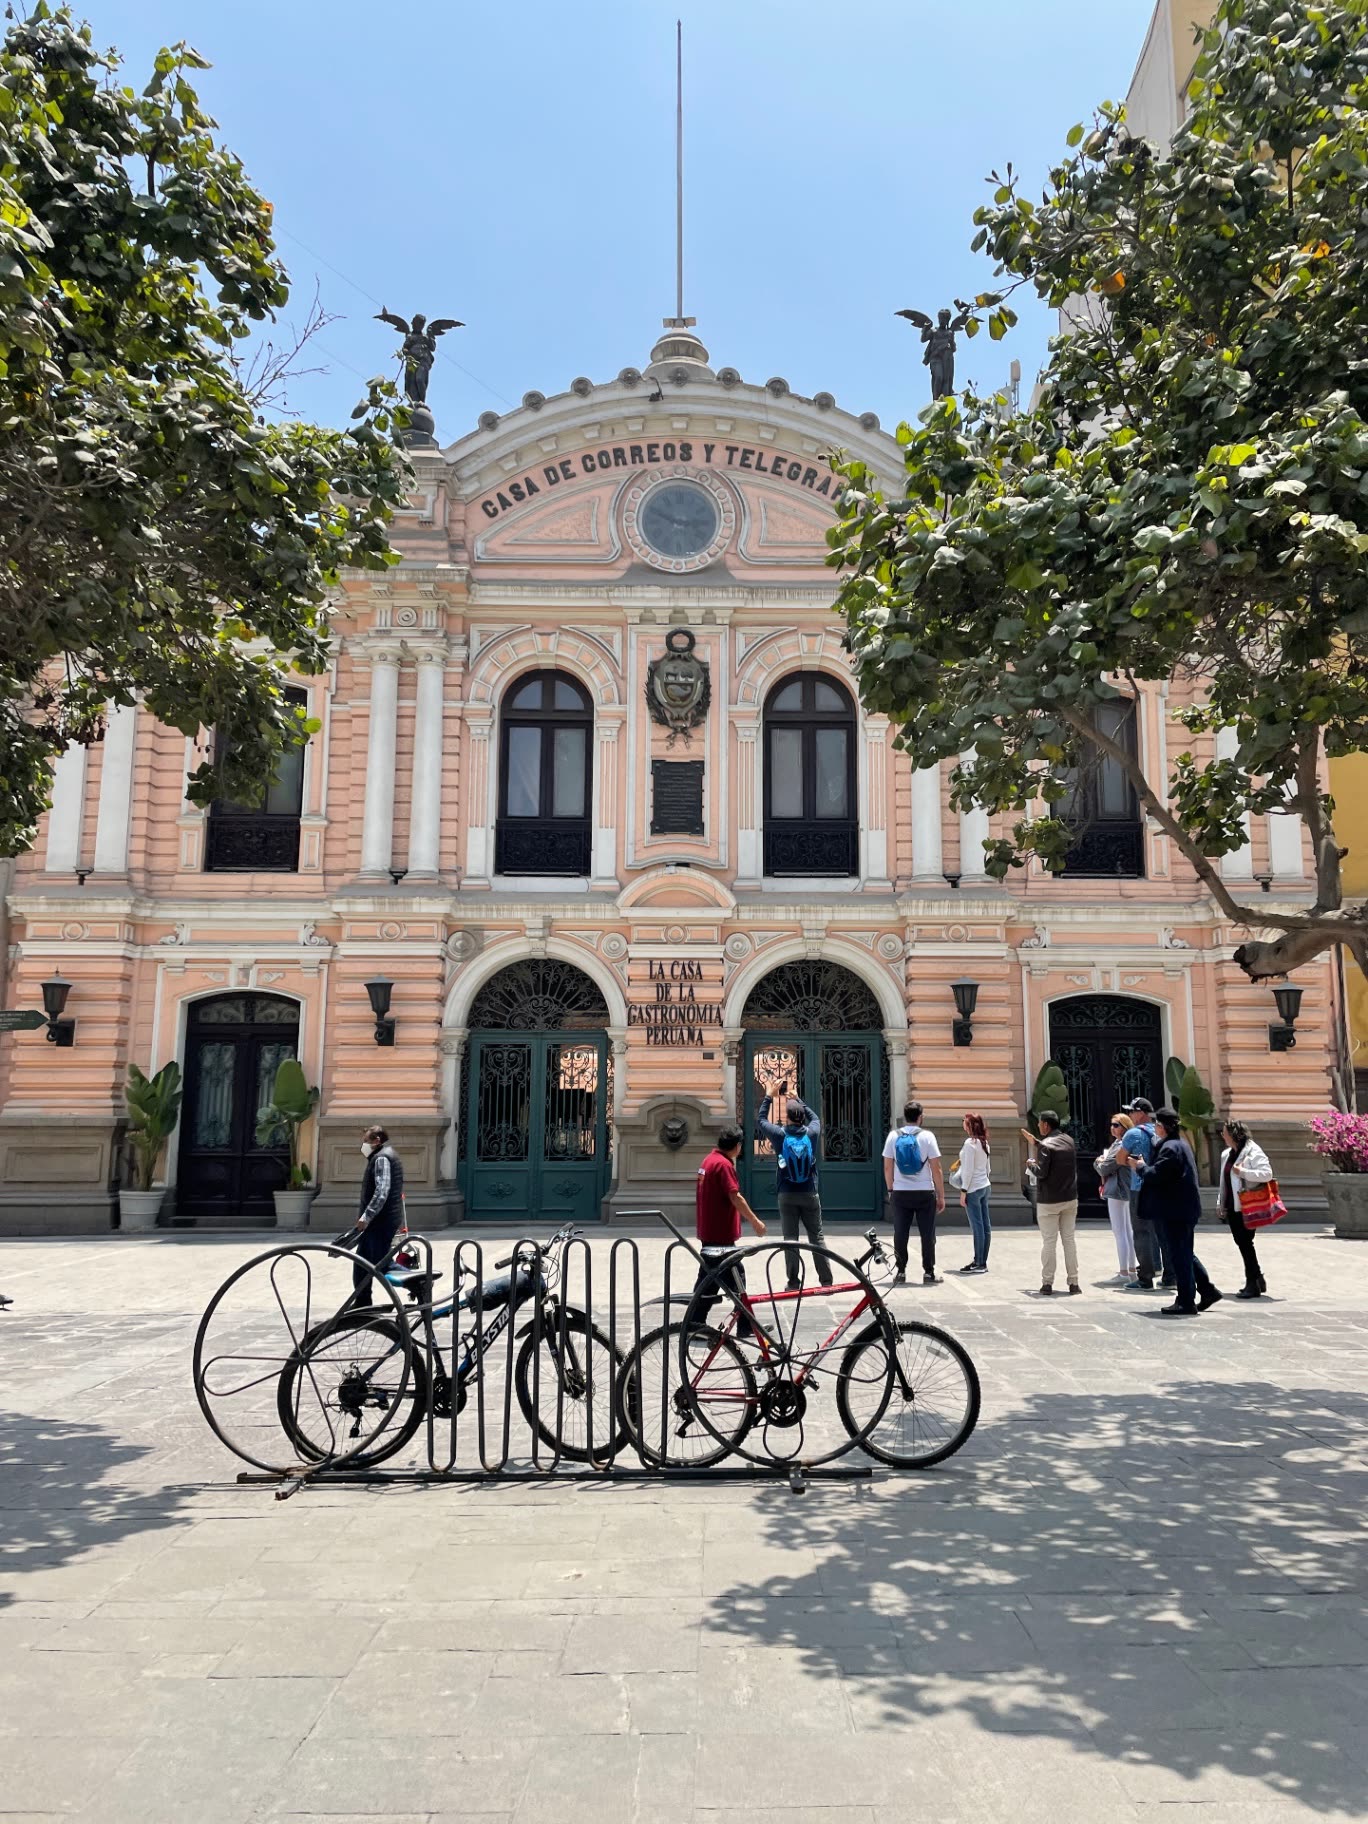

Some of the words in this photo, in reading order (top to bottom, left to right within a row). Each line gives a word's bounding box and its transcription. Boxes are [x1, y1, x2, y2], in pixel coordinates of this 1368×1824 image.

[481, 475, 540, 518] CASA
[543, 459, 577, 486] DE
[581, 443, 693, 473] CORREOS
[703, 444, 715, 463] Y
[649, 960, 665, 980] LA
[671, 960, 703, 980] CASA
[656, 983, 672, 1002] DE
[680, 983, 695, 1002] LA
[628, 1004, 722, 1024] GASTRONOMIA
[646, 1026, 704, 1046] PERUANA
